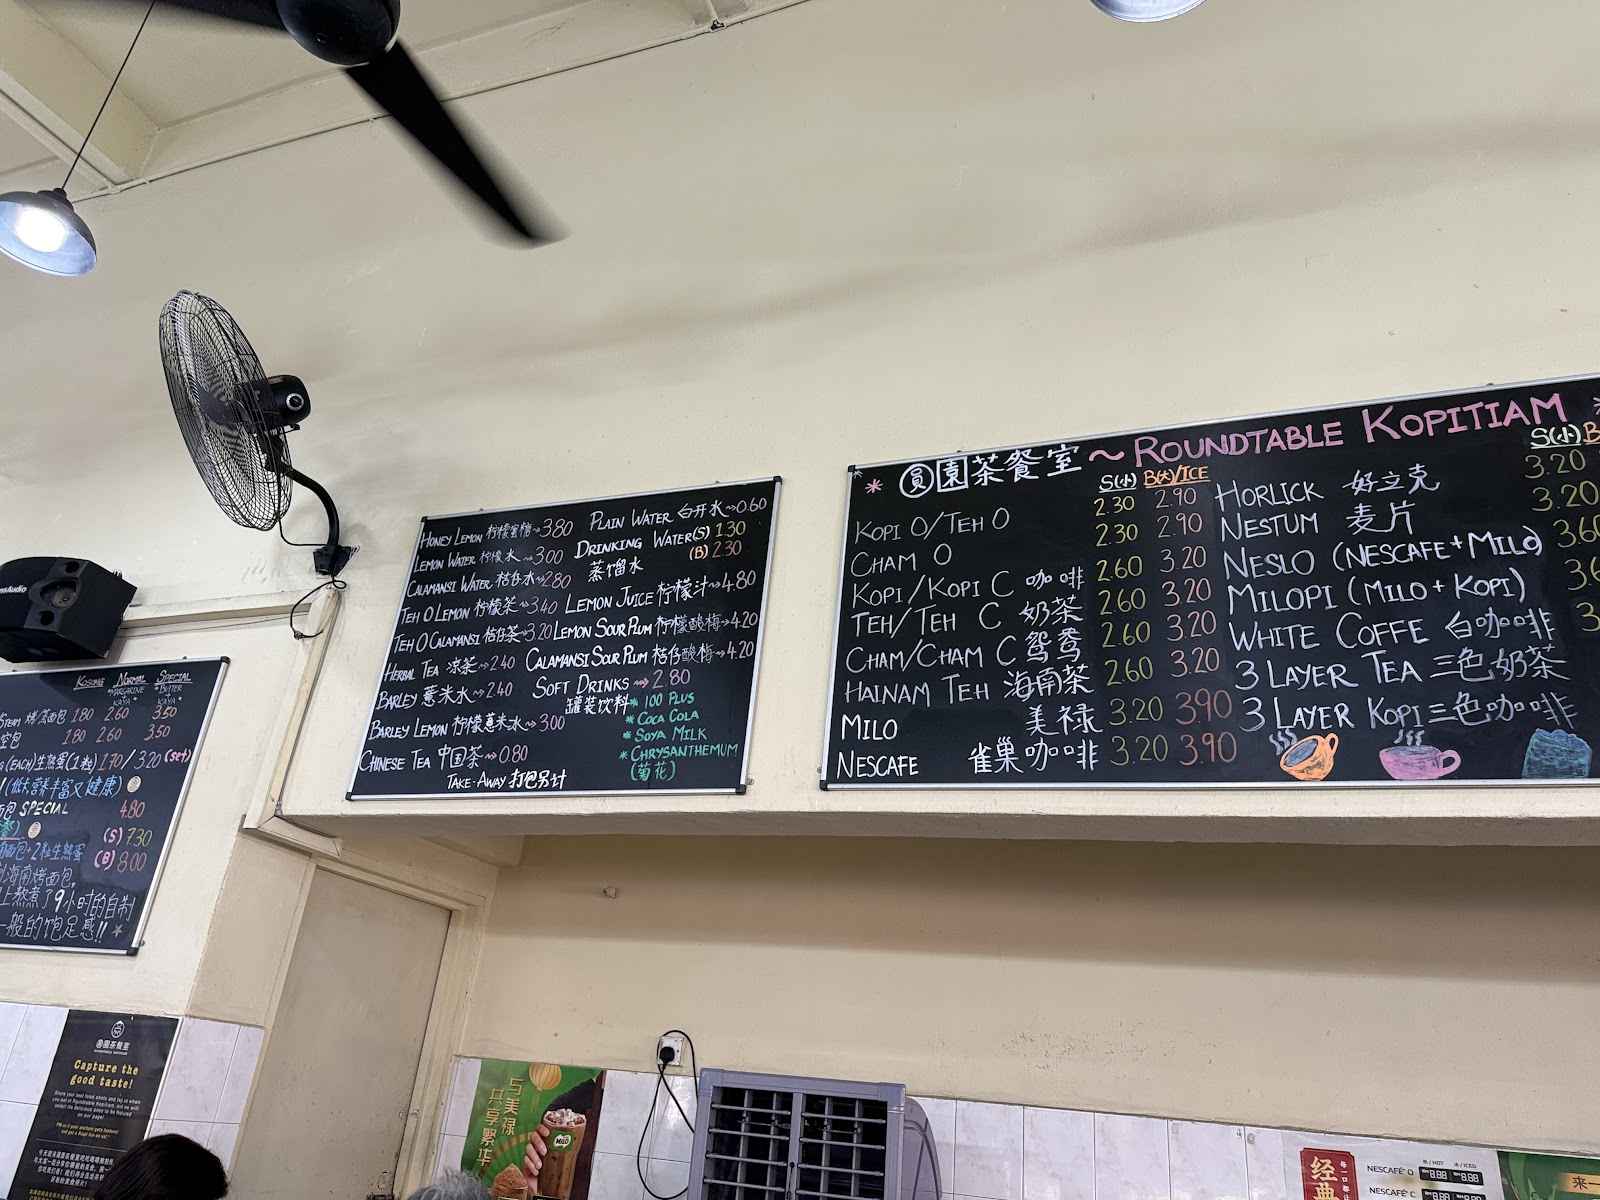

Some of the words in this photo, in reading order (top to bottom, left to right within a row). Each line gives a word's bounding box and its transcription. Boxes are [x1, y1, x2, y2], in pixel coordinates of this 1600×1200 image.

[1134, 421, 1344, 467] ROUNDTABLE
[1361, 392, 1567, 443] KOPITIAM
[1524, 449, 1586, 479] 3.20
[1093, 496, 1135, 516] 2.30
[1154, 487, 1197, 509] 2.90
[1214, 480, 1325, 512] HORLICK
[1532, 480, 1599, 512] 3.20
[589, 511, 625, 532] PLAIN
[631, 509, 674, 527] WATER
[736, 497, 767, 514] 0.60
[854, 521, 901, 544] KOPI
[991, 507, 1010, 530] O
[1156, 513, 1203, 538] 2.90
[1220, 512, 1319, 542] NESTUM
[419, 531, 451, 549] HONEY
[454, 527, 483, 545] LEMON
[574, 537, 642, 560] DRINKING
[715, 520, 746, 538] 1.30
[1095, 524, 1138, 547] 2.30
[413, 555, 444, 573] LEMON
[447, 552, 477, 568] WATER
[688, 545, 709, 561] (B)
[711, 540, 742, 559] 2.30
[850, 552, 917, 578] CHAM
[933, 543, 952, 566] O
[1159, 546, 1207, 573] 3.20
[1223, 547, 1315, 580] NESLO
[1096, 555, 1143, 582] 2.60
[406, 580, 456, 598] CALAMANSI
[460, 572, 494, 593] WATER
[564, 593, 613, 614] LEMON
[615, 585, 654, 608] JUICE
[721, 569, 756, 593] 4.80
[991, 570, 1015, 597] C
[1161, 578, 1212, 607] 3.20
[1098, 588, 1146, 616] 2.60
[1227, 583, 1338, 615] MILOPI
[400, 606, 420, 625] TEH
[434, 603, 471, 622] LEMON
[553, 620, 592, 641] LEMON
[594, 616, 626, 638] SOUR
[626, 615, 652, 637] PLUM
[730, 611, 758, 630] 4.20
[978, 602, 1001, 630] C
[1166, 610, 1217, 642] 3.20
[393, 633, 415, 654] TEH
[428, 631, 481, 650] CALAMANSI
[1100, 621, 1151, 648] 2.60
[1228, 621, 1320, 651] WHITE
[1336, 611, 1429, 649] COFFE
[383, 662, 416, 682] HERBAL
[421, 659, 439, 680] TEA
[489, 654, 516, 671] 2.40
[525, 647, 589, 672] CALAMANSI
[726, 641, 754, 661] 4.20
[1170, 647, 1220, 678] 3.20
[1234, 660, 1260, 690] 3
[1266, 659, 1359, 690] LAYER
[1361, 649, 1423, 684] TEA
[154, 669, 193, 686] SPECIAL
[532, 676, 571, 699] SOFT
[576, 674, 630, 695] DRINKS
[651, 668, 691, 690] 2.80
[1104, 656, 1154, 687] 2.60
[375, 691, 418, 711] BARLEY
[486, 682, 513, 699] 2.40
[644, 695, 663, 708] 100
[668, 692, 695, 706] PLUS
[843, 679, 931, 708] HAINAM
[940, 673, 990, 704] TEH
[104, 706, 130, 721] 2.60
[637, 712, 666, 726] COCA
[669, 708, 699, 723] COLA
[1108, 696, 1164, 726] 3.20
[1175, 688, 1233, 726] 3.90
[1239, 697, 1266, 732] 3
[1274, 697, 1356, 730] LAYER
[1367, 696, 1424, 729] KOPI
[96, 726, 122, 744] 2.60
[143, 723, 171, 741] 3.50
[368, 720, 410, 741] BARLEY
[413, 717, 448, 738] LEMON
[634, 728, 667, 743] SOYA
[672, 725, 708, 741] MILK
[841, 713, 898, 741] MILO
[358, 750, 406, 772] CHINESE
[411, 748, 431, 770] TEA
[499, 745, 529, 764] 0.80
[630, 743, 738, 763] CHRYSANTHEMUM
[1110, 734, 1169, 766] 3.20
[1179, 732, 1237, 766] 3.90
[836, 750, 920, 779] NESCAFE
[19, 800, 69, 817] SPECIAL
[119, 799, 146, 818] 4.80
[70, 1074, 96, 1085] good
[99, 1076, 133, 1089] taste!
[74, 1060, 117, 1073] Capture
[121, 1064, 139, 1075] the
